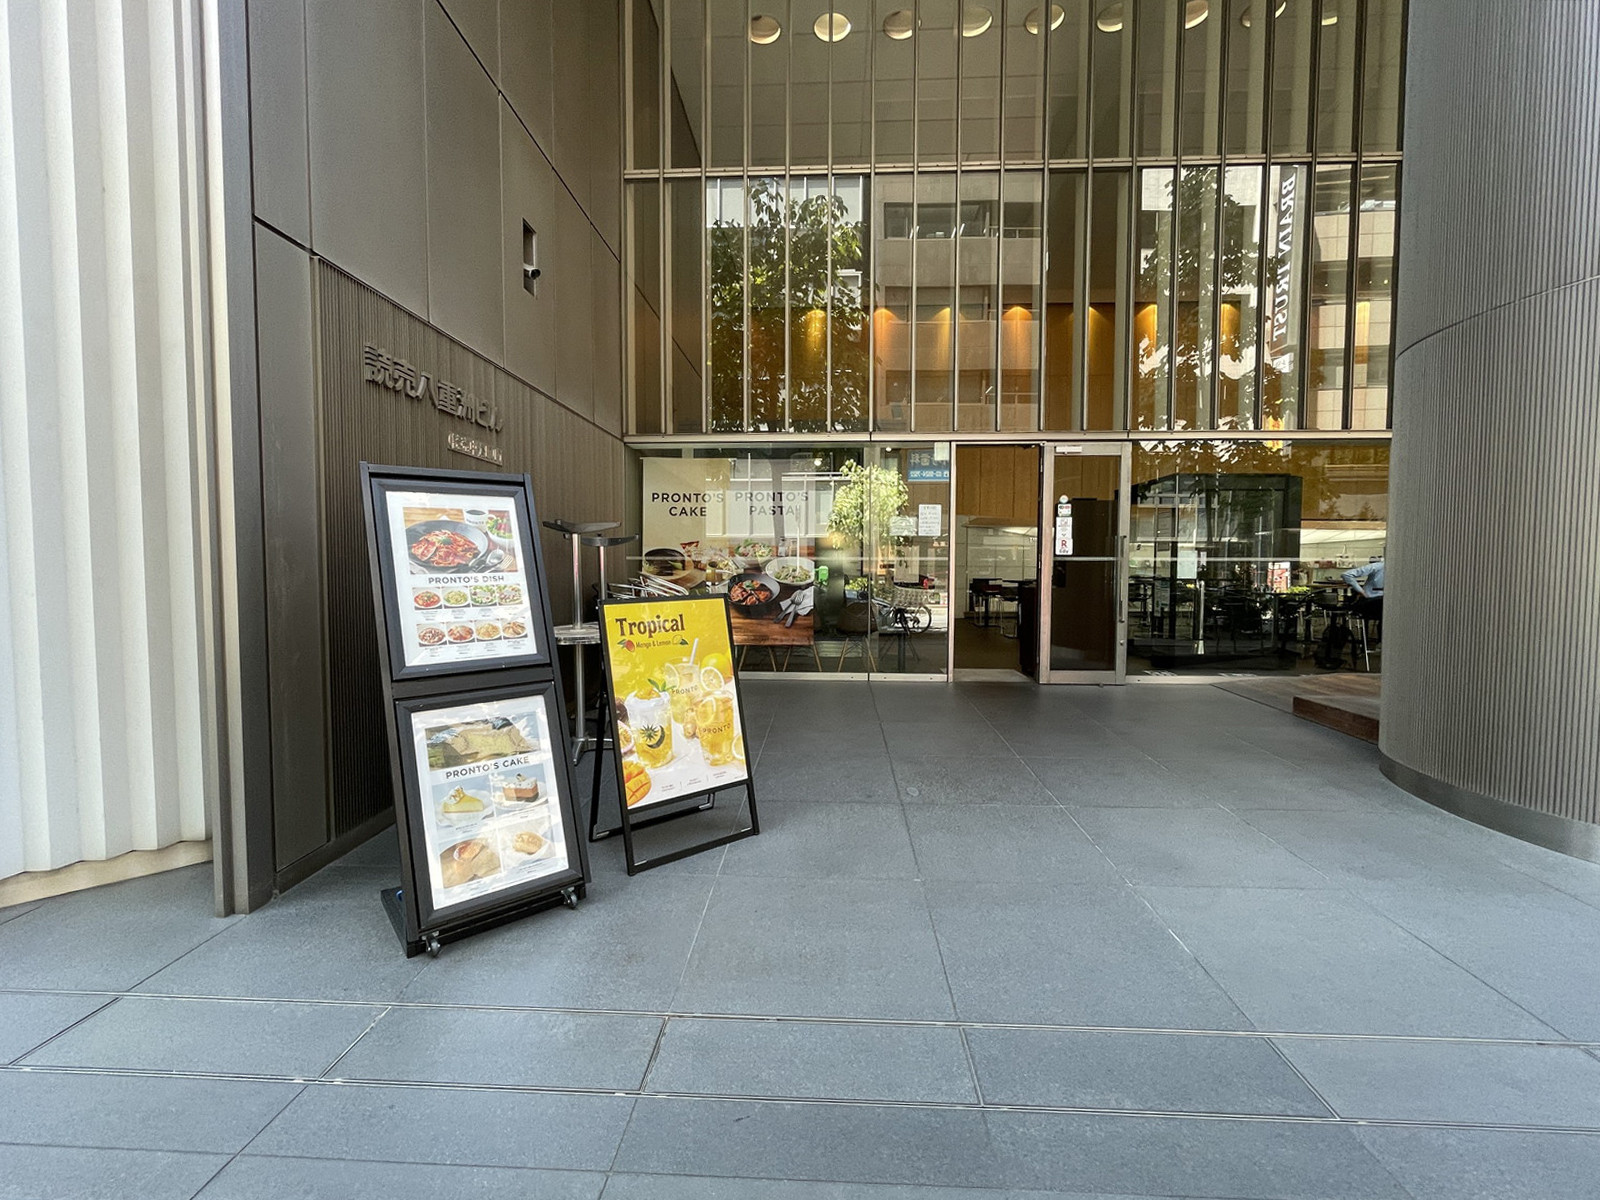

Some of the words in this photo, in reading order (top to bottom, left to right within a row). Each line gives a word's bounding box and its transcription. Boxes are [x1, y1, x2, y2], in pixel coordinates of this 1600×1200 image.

[652, 492, 724, 503] PRONTO'S
[735, 491, 808, 502] PRONTO'S
[669, 506, 706, 517] CAKE
[750, 505, 795, 516] PASTA
[428, 576, 479, 585] PRONTO'S
[482, 575, 504, 583] DISH
[615, 613, 685, 638] Tropical
[446, 762, 499, 779] PRONTO'S
[502, 756, 530, 768] CAKE
